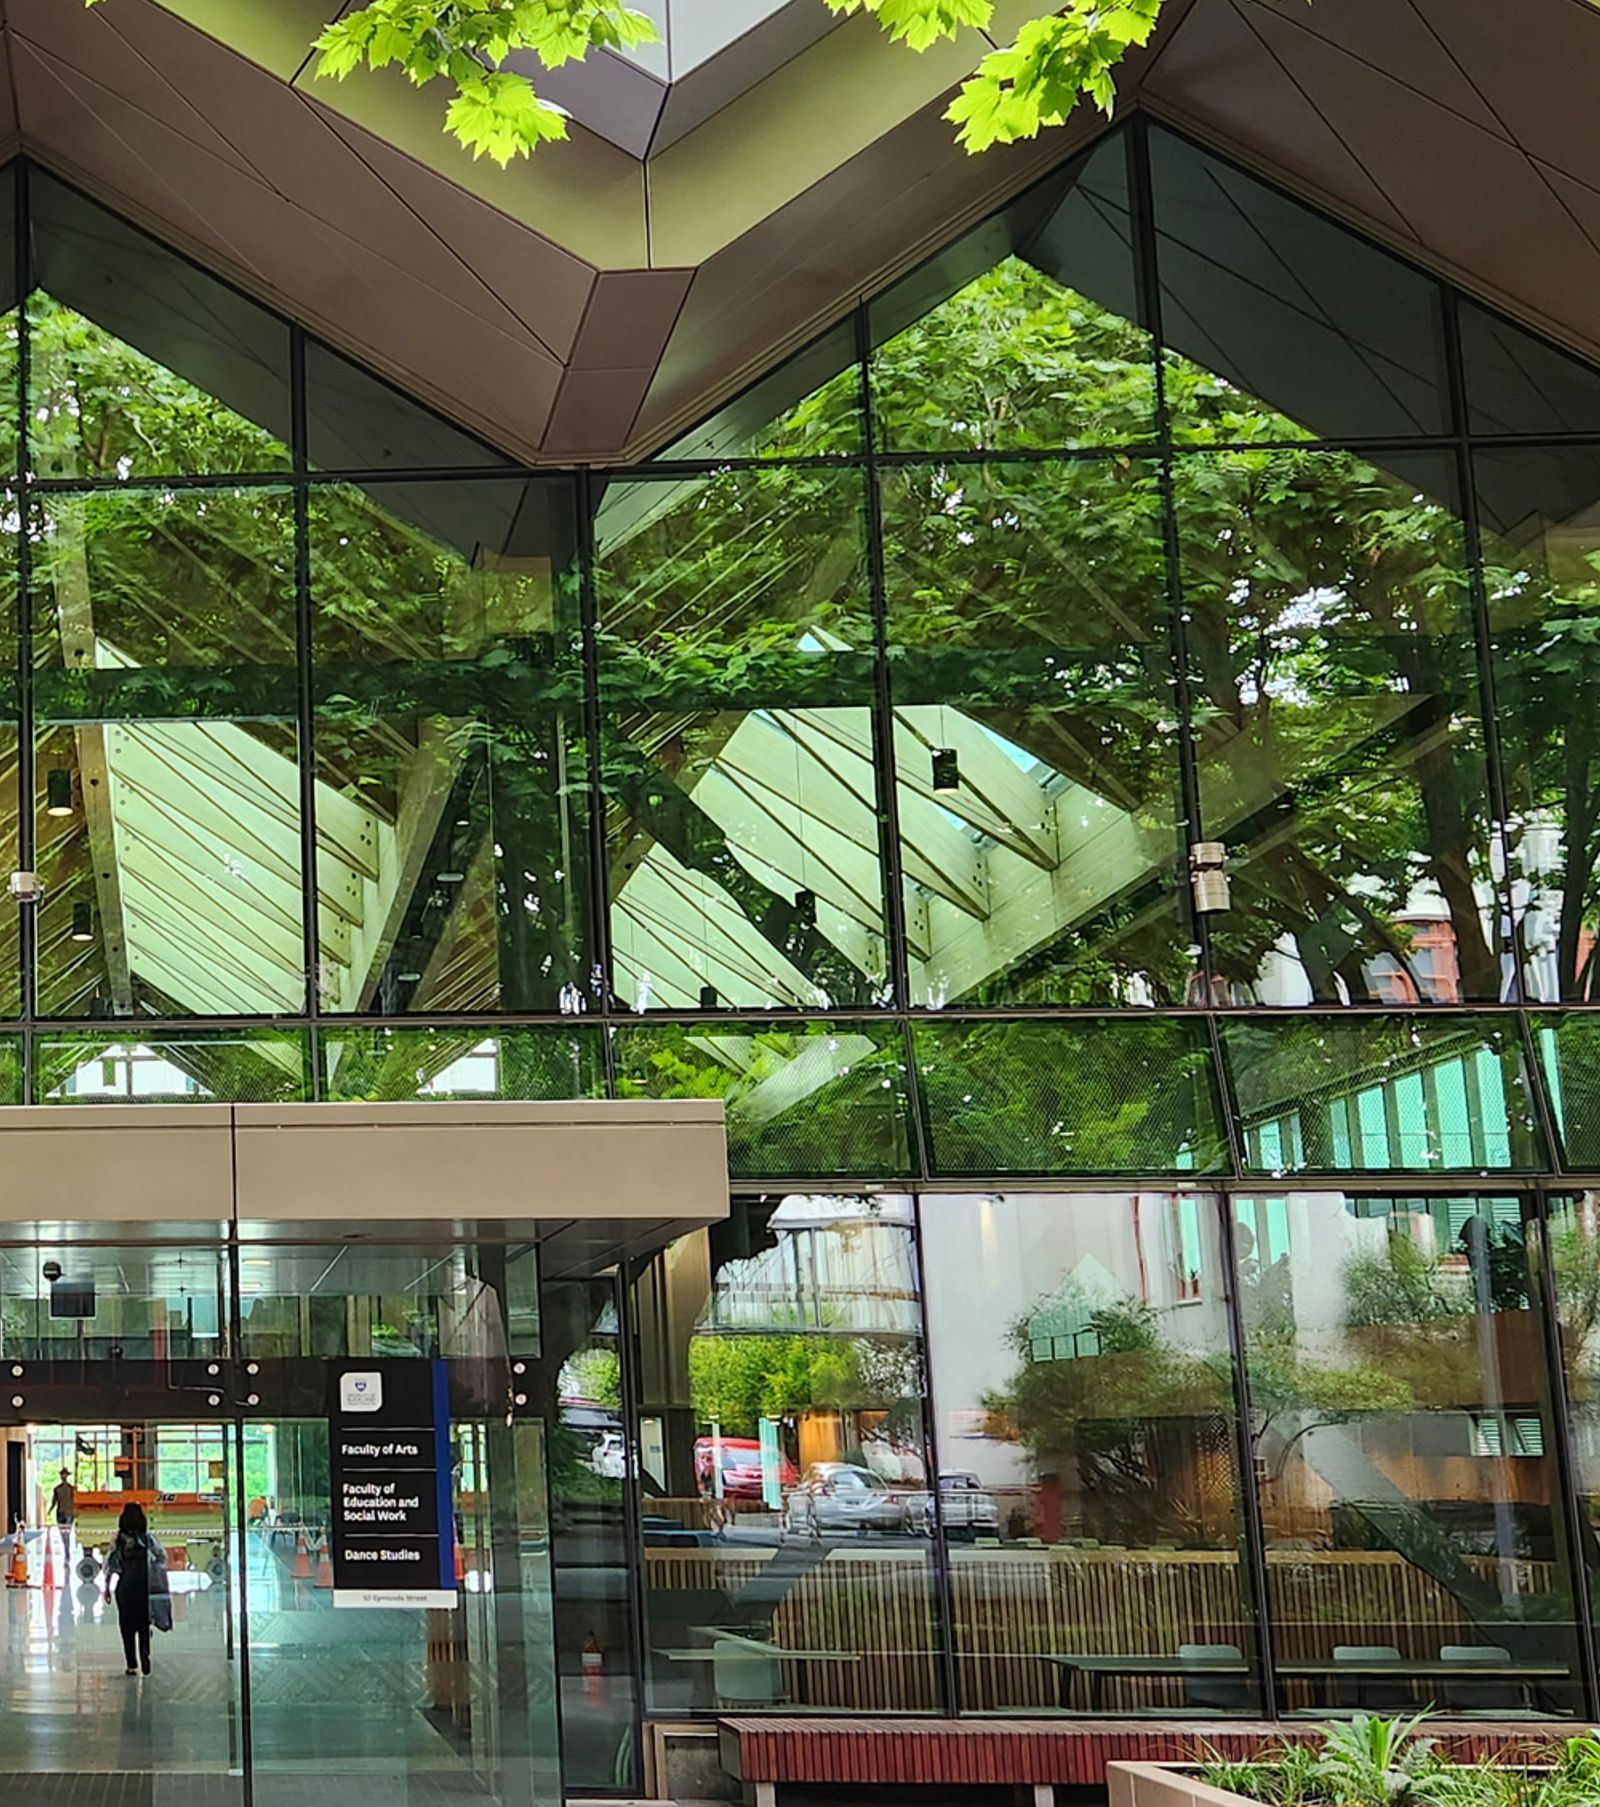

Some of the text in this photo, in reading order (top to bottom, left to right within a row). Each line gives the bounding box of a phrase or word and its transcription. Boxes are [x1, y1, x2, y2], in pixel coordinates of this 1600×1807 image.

[342, 1443, 418, 1458] Faculty of Arts
[343, 1482, 396, 1497] Faculty of
[343, 1496, 419, 1508] Education and
[344, 1510, 407, 1521] Social Work
[345, 1548, 420, 1561] Dance Studies
